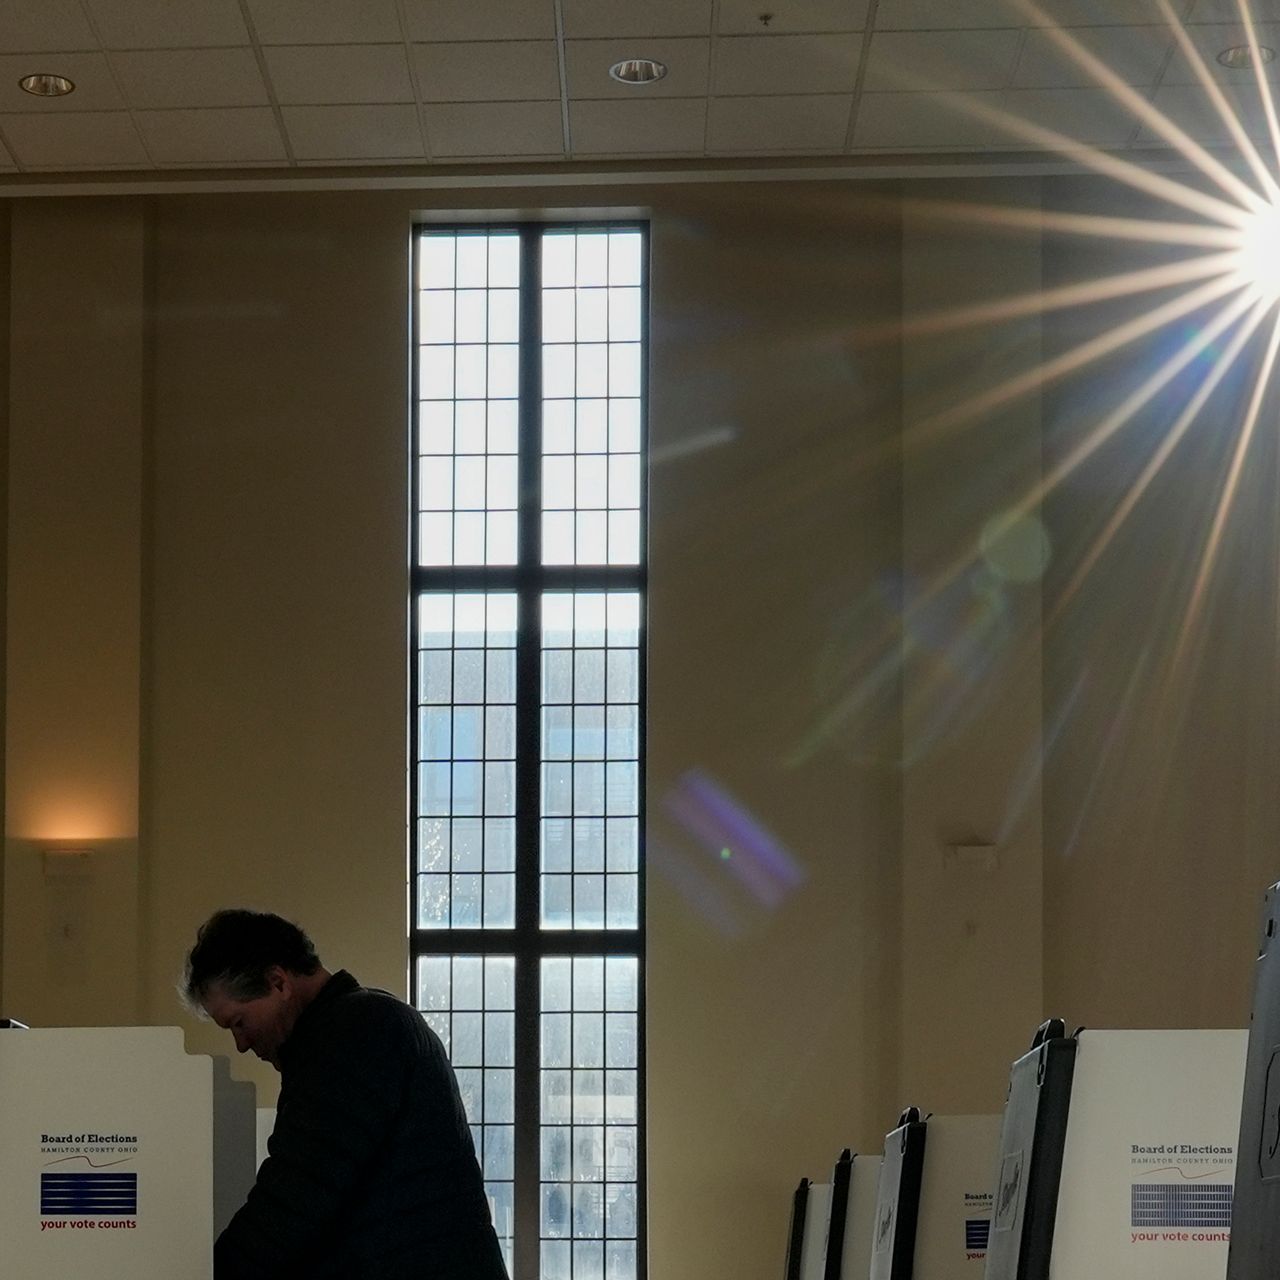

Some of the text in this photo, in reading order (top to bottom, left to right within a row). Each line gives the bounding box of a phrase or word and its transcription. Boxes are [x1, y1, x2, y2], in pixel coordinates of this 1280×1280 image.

[41, 1134, 138, 1143] Board of Elections
[1131, 1145, 1233, 1154] Board of Elections
[40, 1220, 137, 1231] your vote counts
[1131, 1232, 1232, 1243] your vote counts
